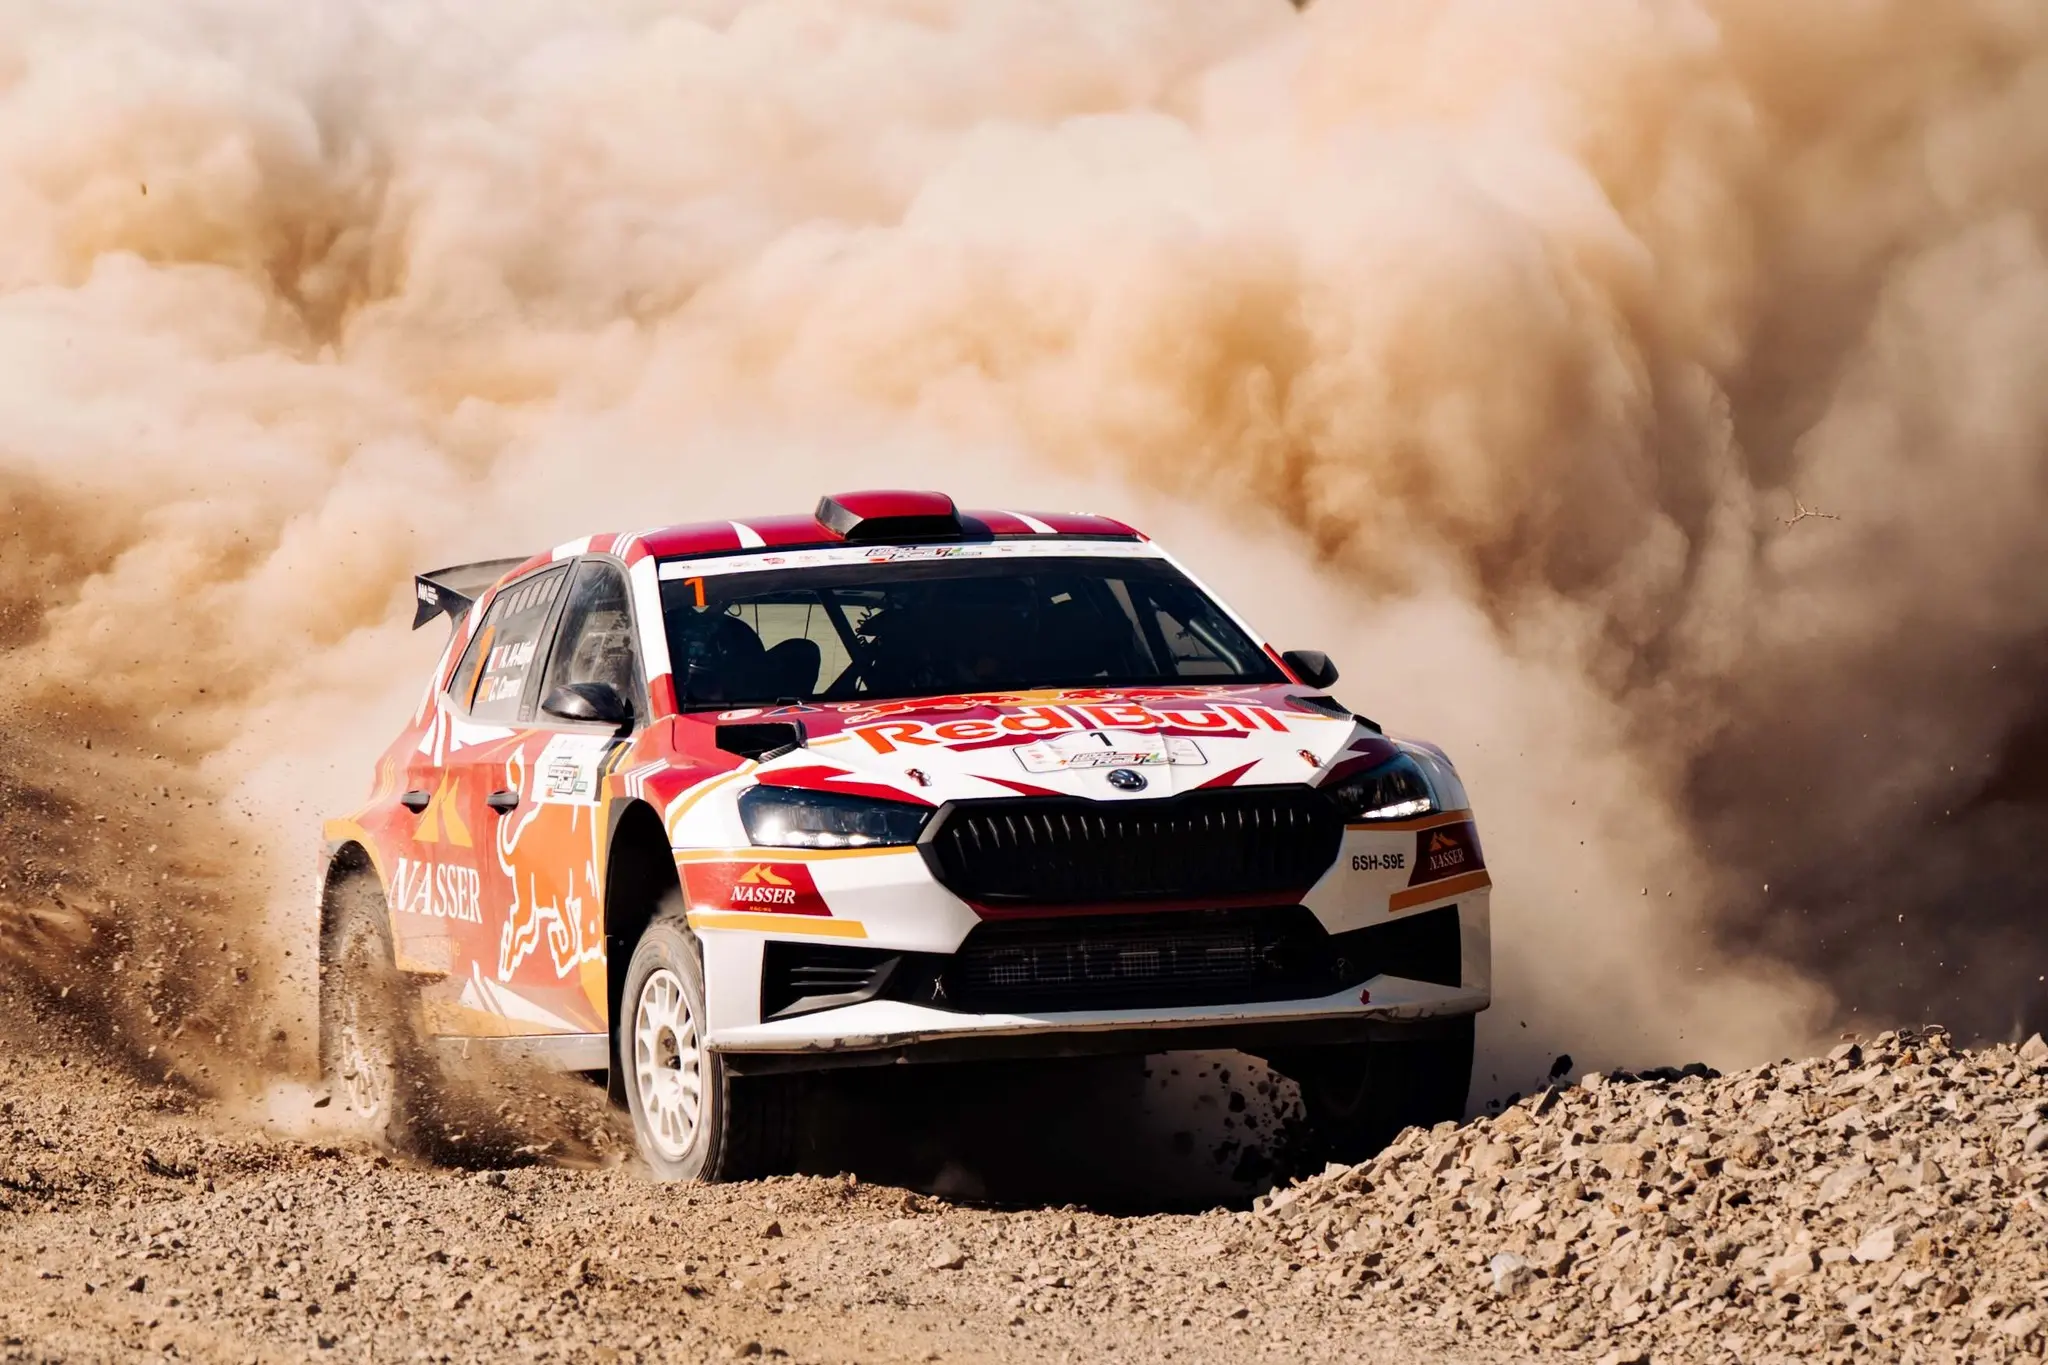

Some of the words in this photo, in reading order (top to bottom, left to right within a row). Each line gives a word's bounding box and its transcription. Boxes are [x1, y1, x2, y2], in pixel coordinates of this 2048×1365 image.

[683, 576, 708, 608] 1
[853, 706, 1074, 755] Red
[1084, 705, 1291, 733] Bull
[1089, 731, 1113, 747] 1
[1351, 853, 1405, 871] 6SH-S9E
[1429, 847, 1465, 871] NASSER
[388, 857, 483, 924] NASSER
[730, 885, 796, 905] NASSER
